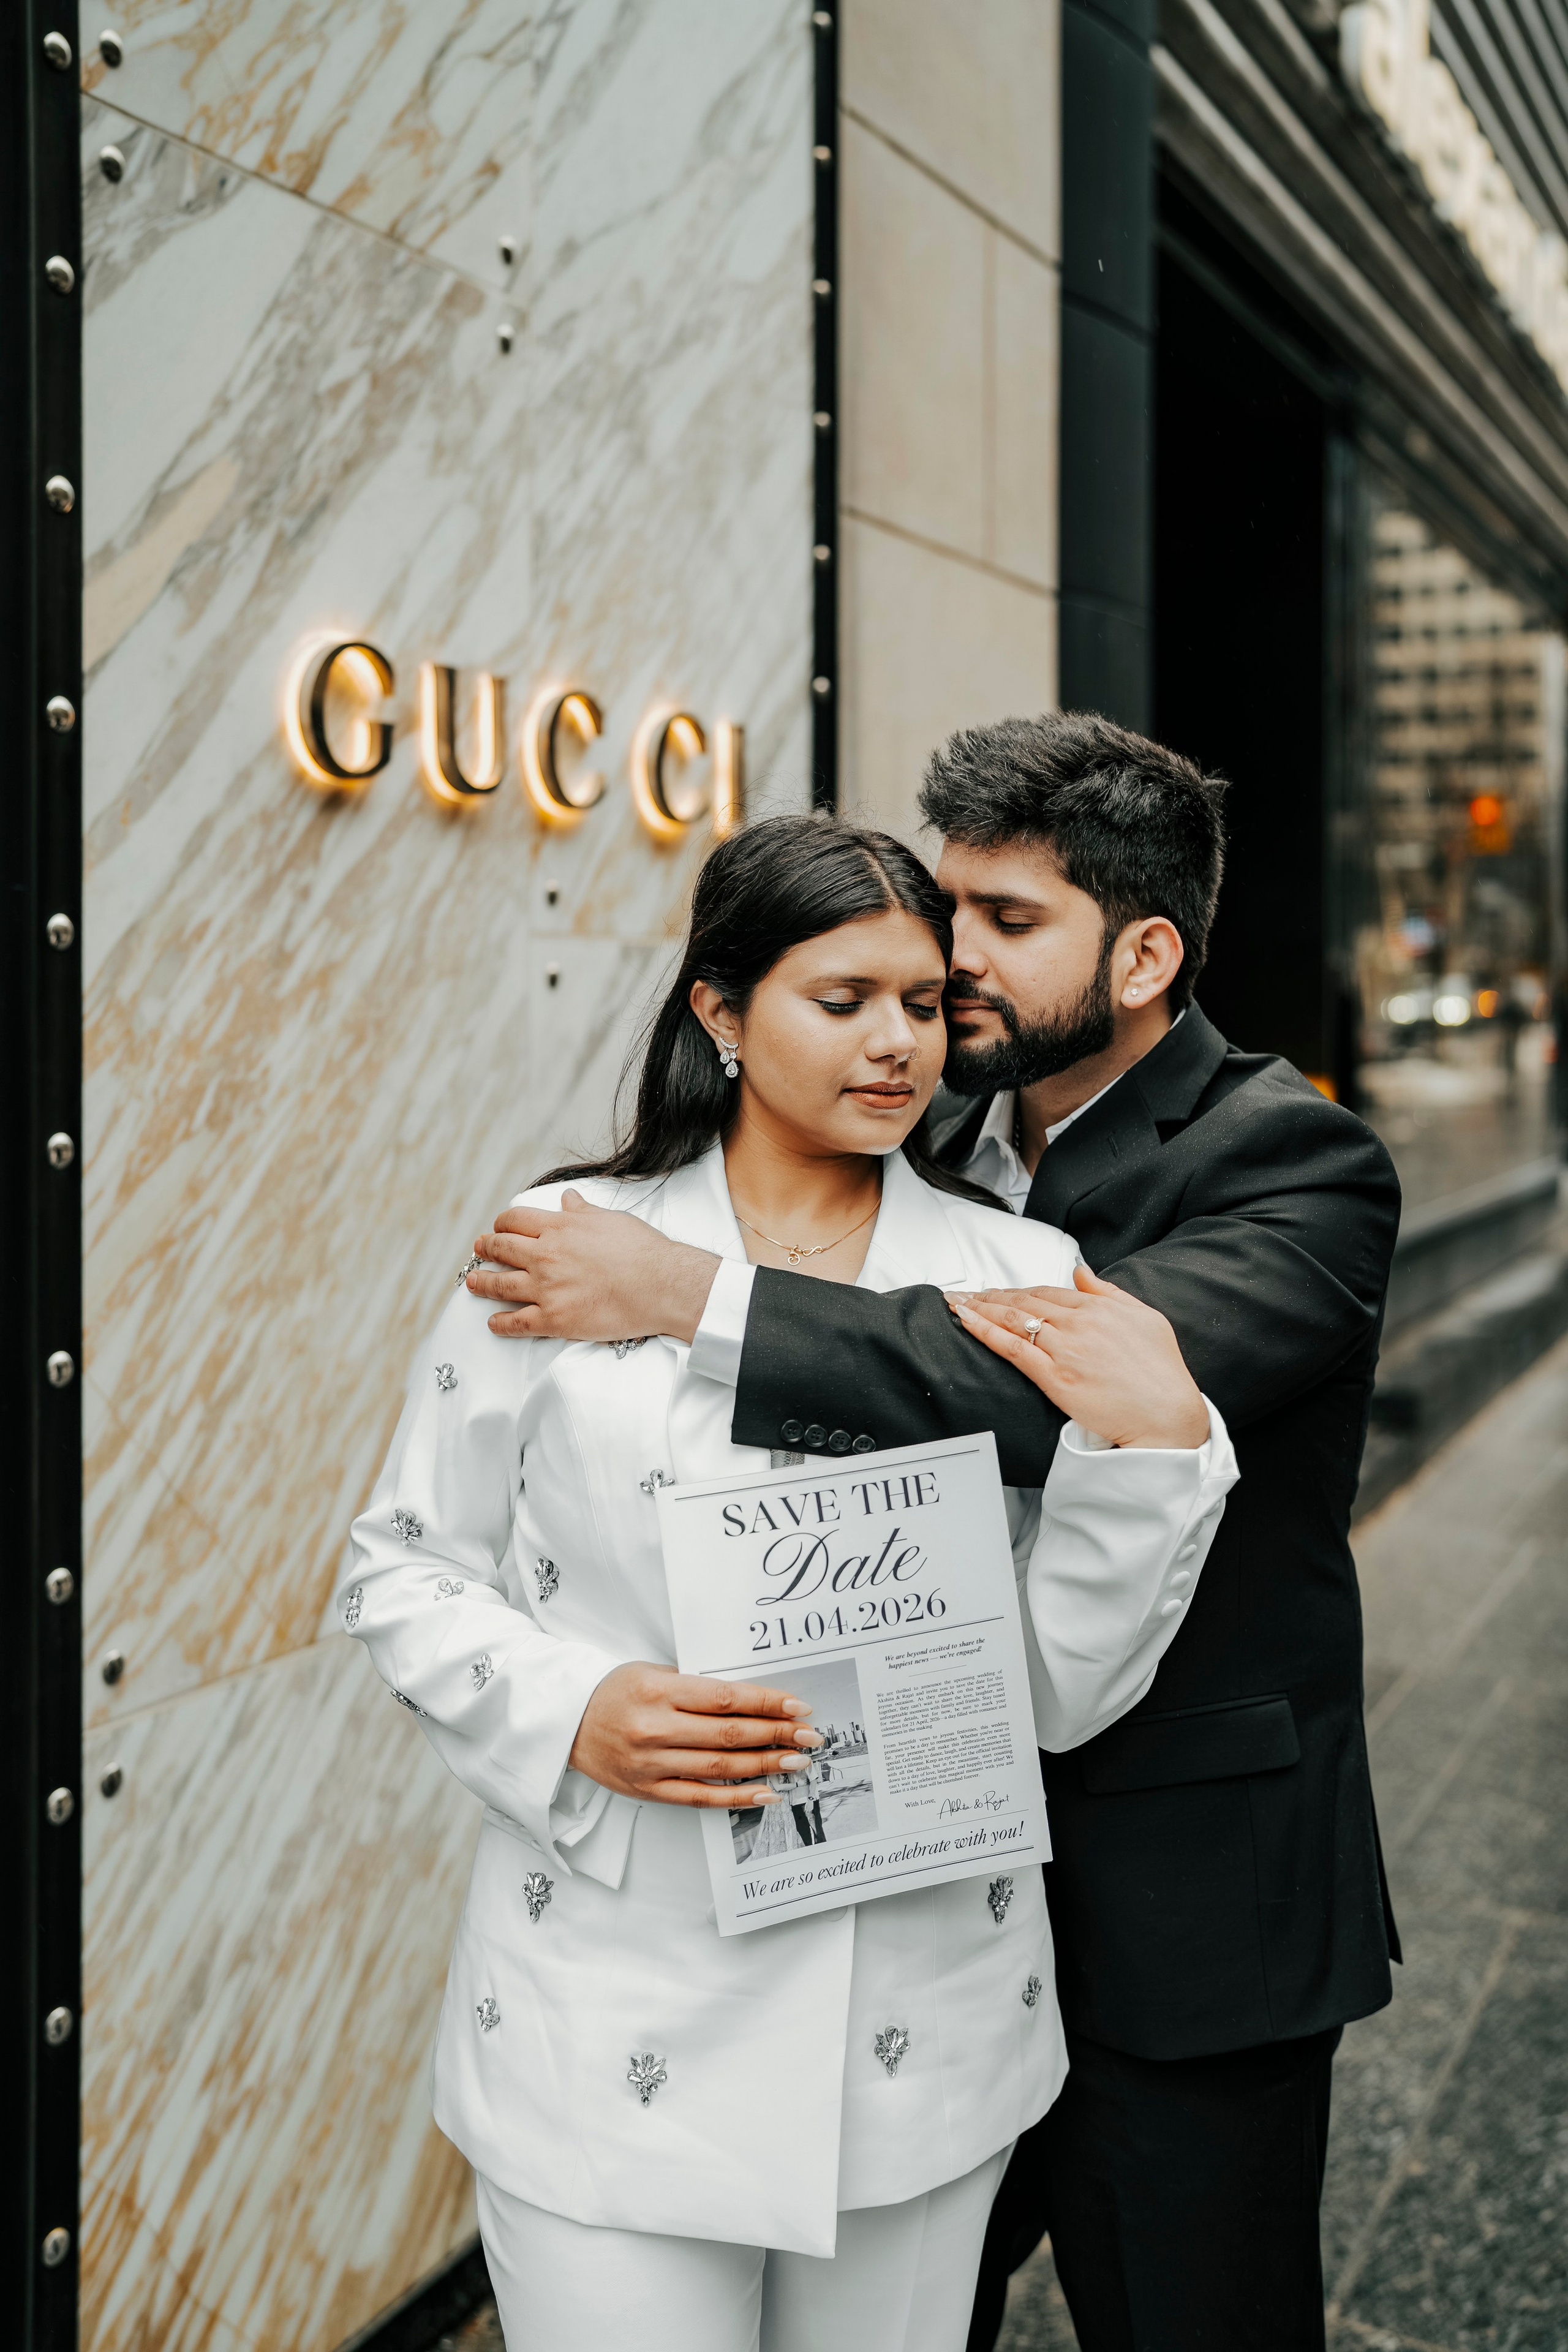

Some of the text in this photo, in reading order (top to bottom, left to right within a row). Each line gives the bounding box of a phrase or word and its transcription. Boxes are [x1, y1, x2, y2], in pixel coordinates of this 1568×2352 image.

[295, 641, 746, 831] GUCCI
[722, 1472, 940, 1537] SAVE THE
[756, 1527, 927, 1606] Date
[750, 1588, 946, 1651] 21.04.2026
[888, 1660, 913, 1670] happiest
[956, 1645, 982, 1656] engaged!
[907, 1648, 927, 1658] beyond
[929, 1643, 950, 1653] excited
[879, 1711, 908, 1721] unforgettable
[961, 1736, 985, 1745] celebration
[981, 1738, 1002, 1747] memories
[991, 1742, 1012, 1751] invitation
[957, 1755, 980, 1763] meantime,
[993, 1749, 1013, 1758] counting
[974, 1798, 983, 1809] &
[983, 1790, 1009, 1811] Rajat
[743, 1820, 1025, 1900] We are so excited to celebrate with you!
